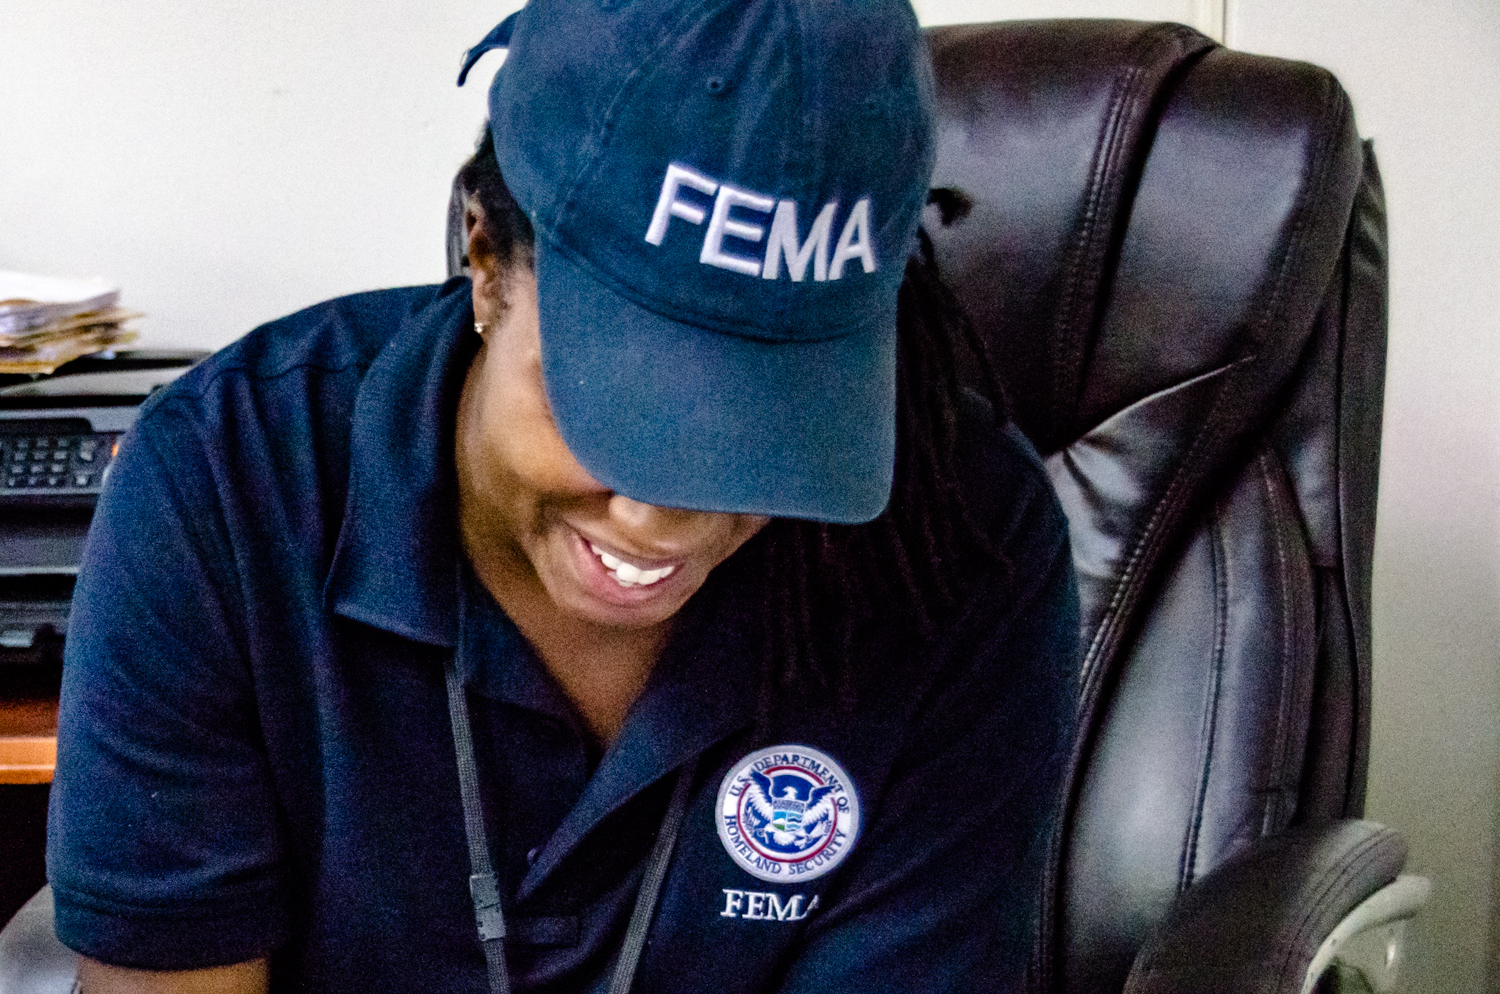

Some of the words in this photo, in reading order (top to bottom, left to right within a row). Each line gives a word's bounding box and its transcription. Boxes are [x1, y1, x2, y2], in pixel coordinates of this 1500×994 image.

[645, 164, 876, 282] FEMA
[754, 753, 844, 793] DEPARTMENT
[835, 791, 850, 814] OF
[724, 815, 782, 875] HOMELAND
[788, 829, 847, 875] SECURITY
